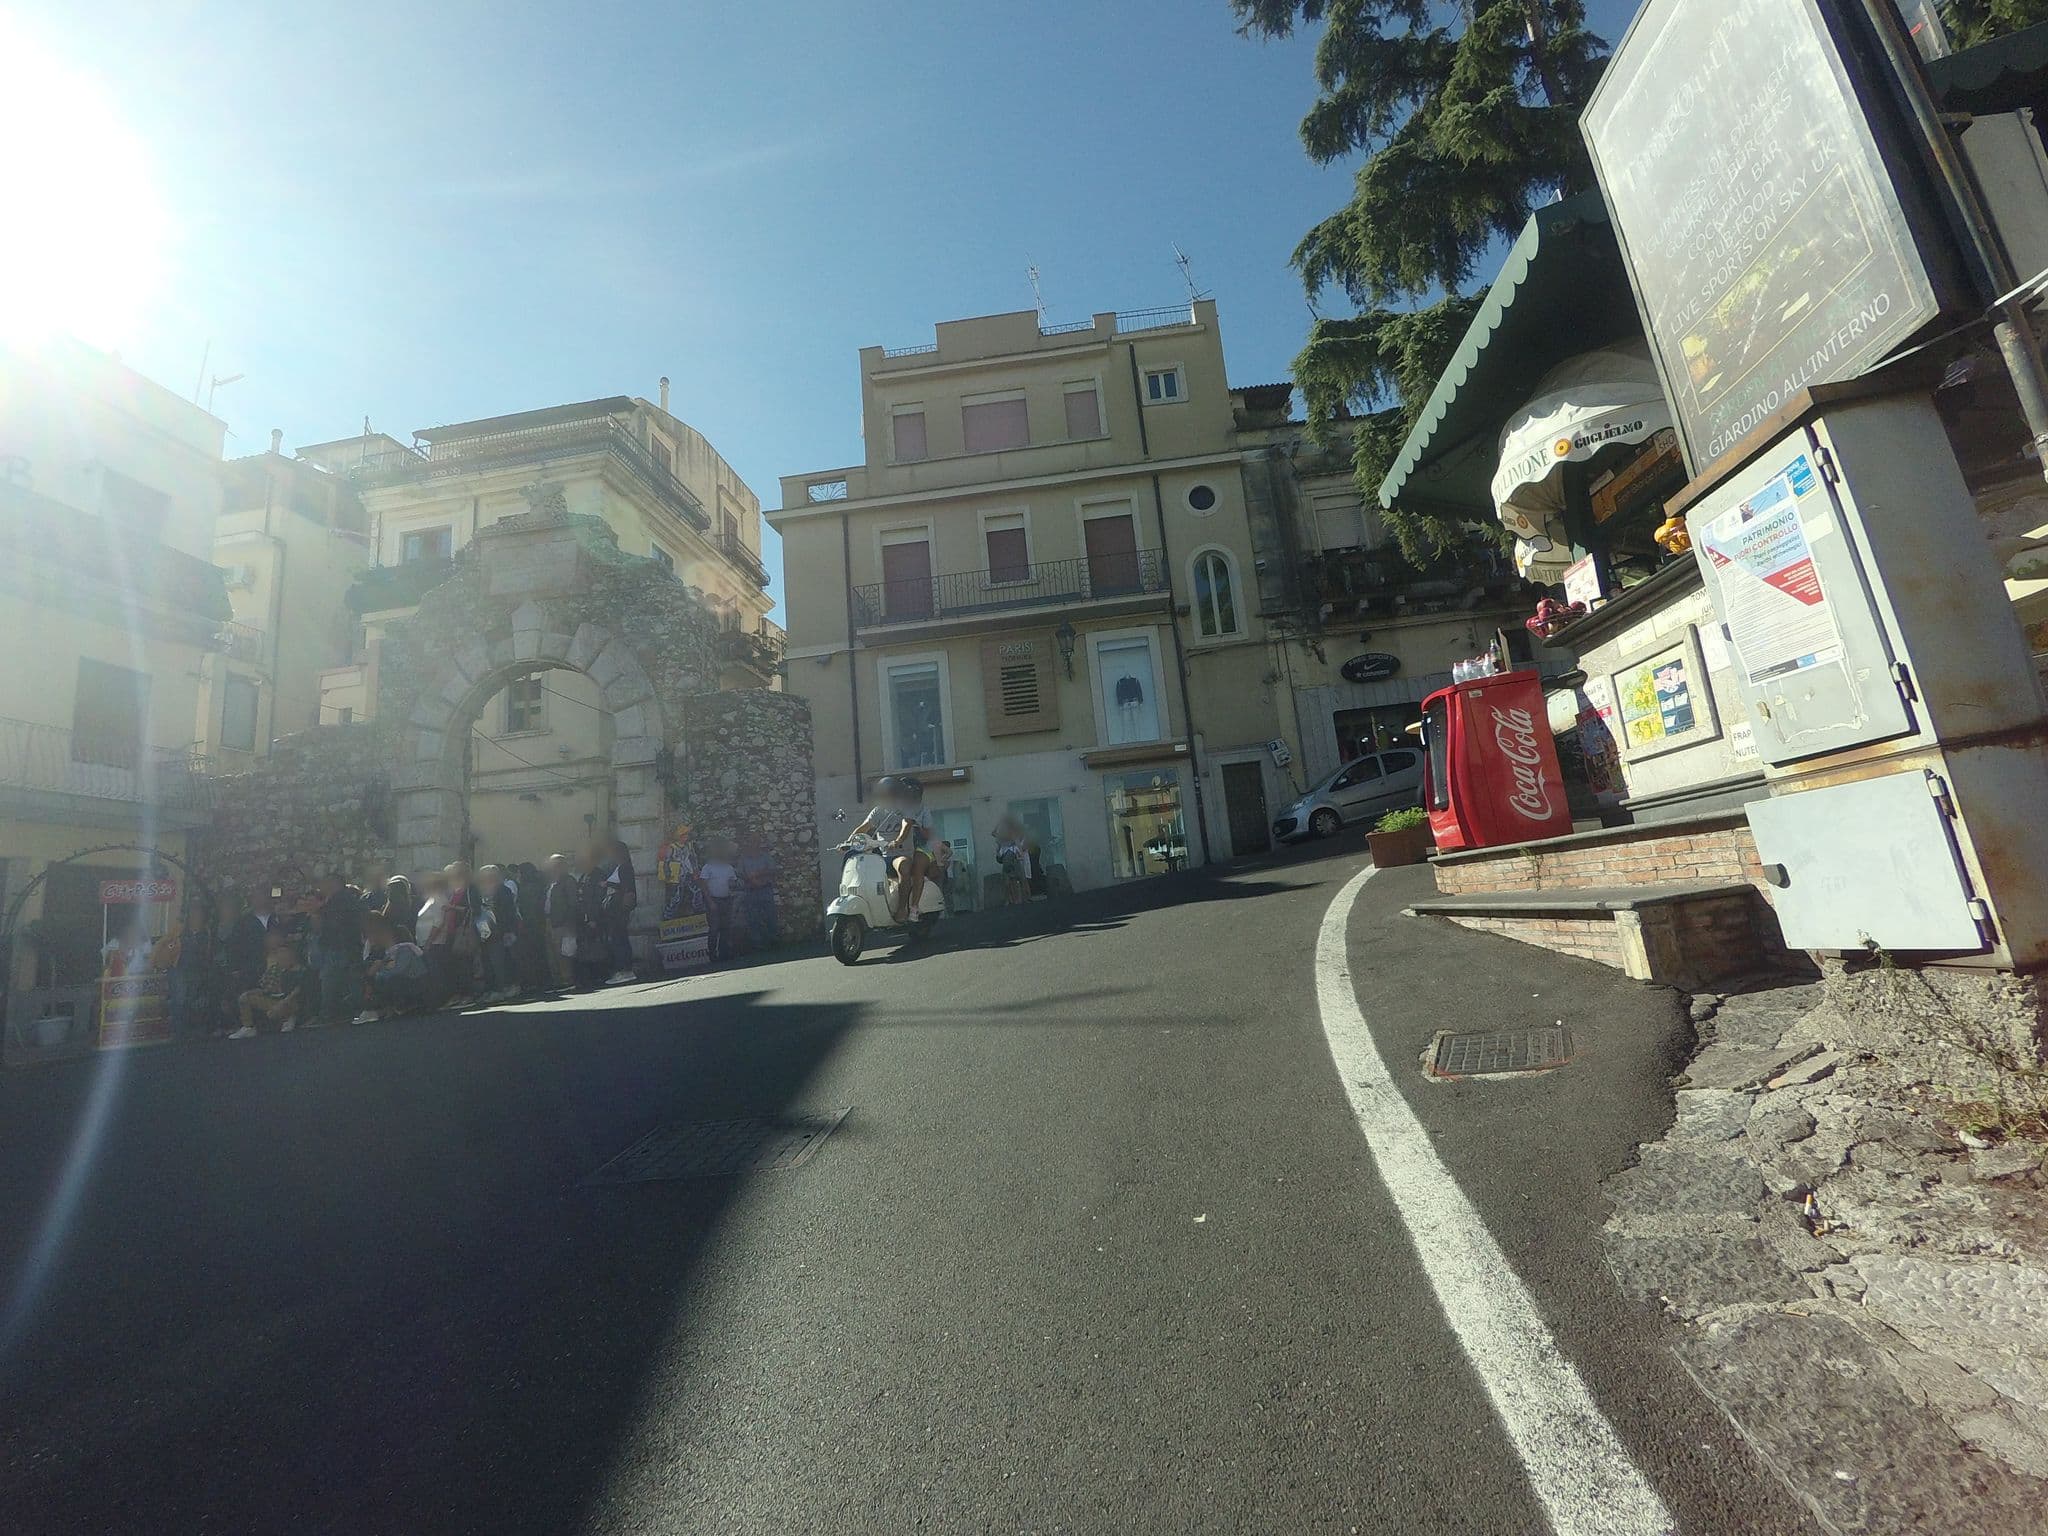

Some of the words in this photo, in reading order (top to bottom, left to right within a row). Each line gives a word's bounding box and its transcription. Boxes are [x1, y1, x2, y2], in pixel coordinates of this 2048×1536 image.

[1665, 180, 1728, 259] GOURMET
[1728, 88, 1793, 184] BURGERS
[1688, 182, 1751, 261] COCKTAIL
[1751, 139, 1782, 182] BAR
[1669, 300, 1702, 335] LIVE
[1701, 242, 1753, 303] SPORTS
[1754, 209, 1778, 242] ON
[1779, 168, 1809, 213] SKY
[1812, 137, 1837, 172] UK
[1707, 390, 1780, 458] GIARDINO
[1783, 292, 1891, 399] ALL'INTERNO
[1574, 420, 1644, 450] GUGLIELMO
[1742, 511, 1795, 545] PATRIMONIO
[1751, 522, 1799, 552] CONTROLLO
[999, 640, 1033, 655] PARISI
[1490, 705, 1553, 821] Coca-Cola
